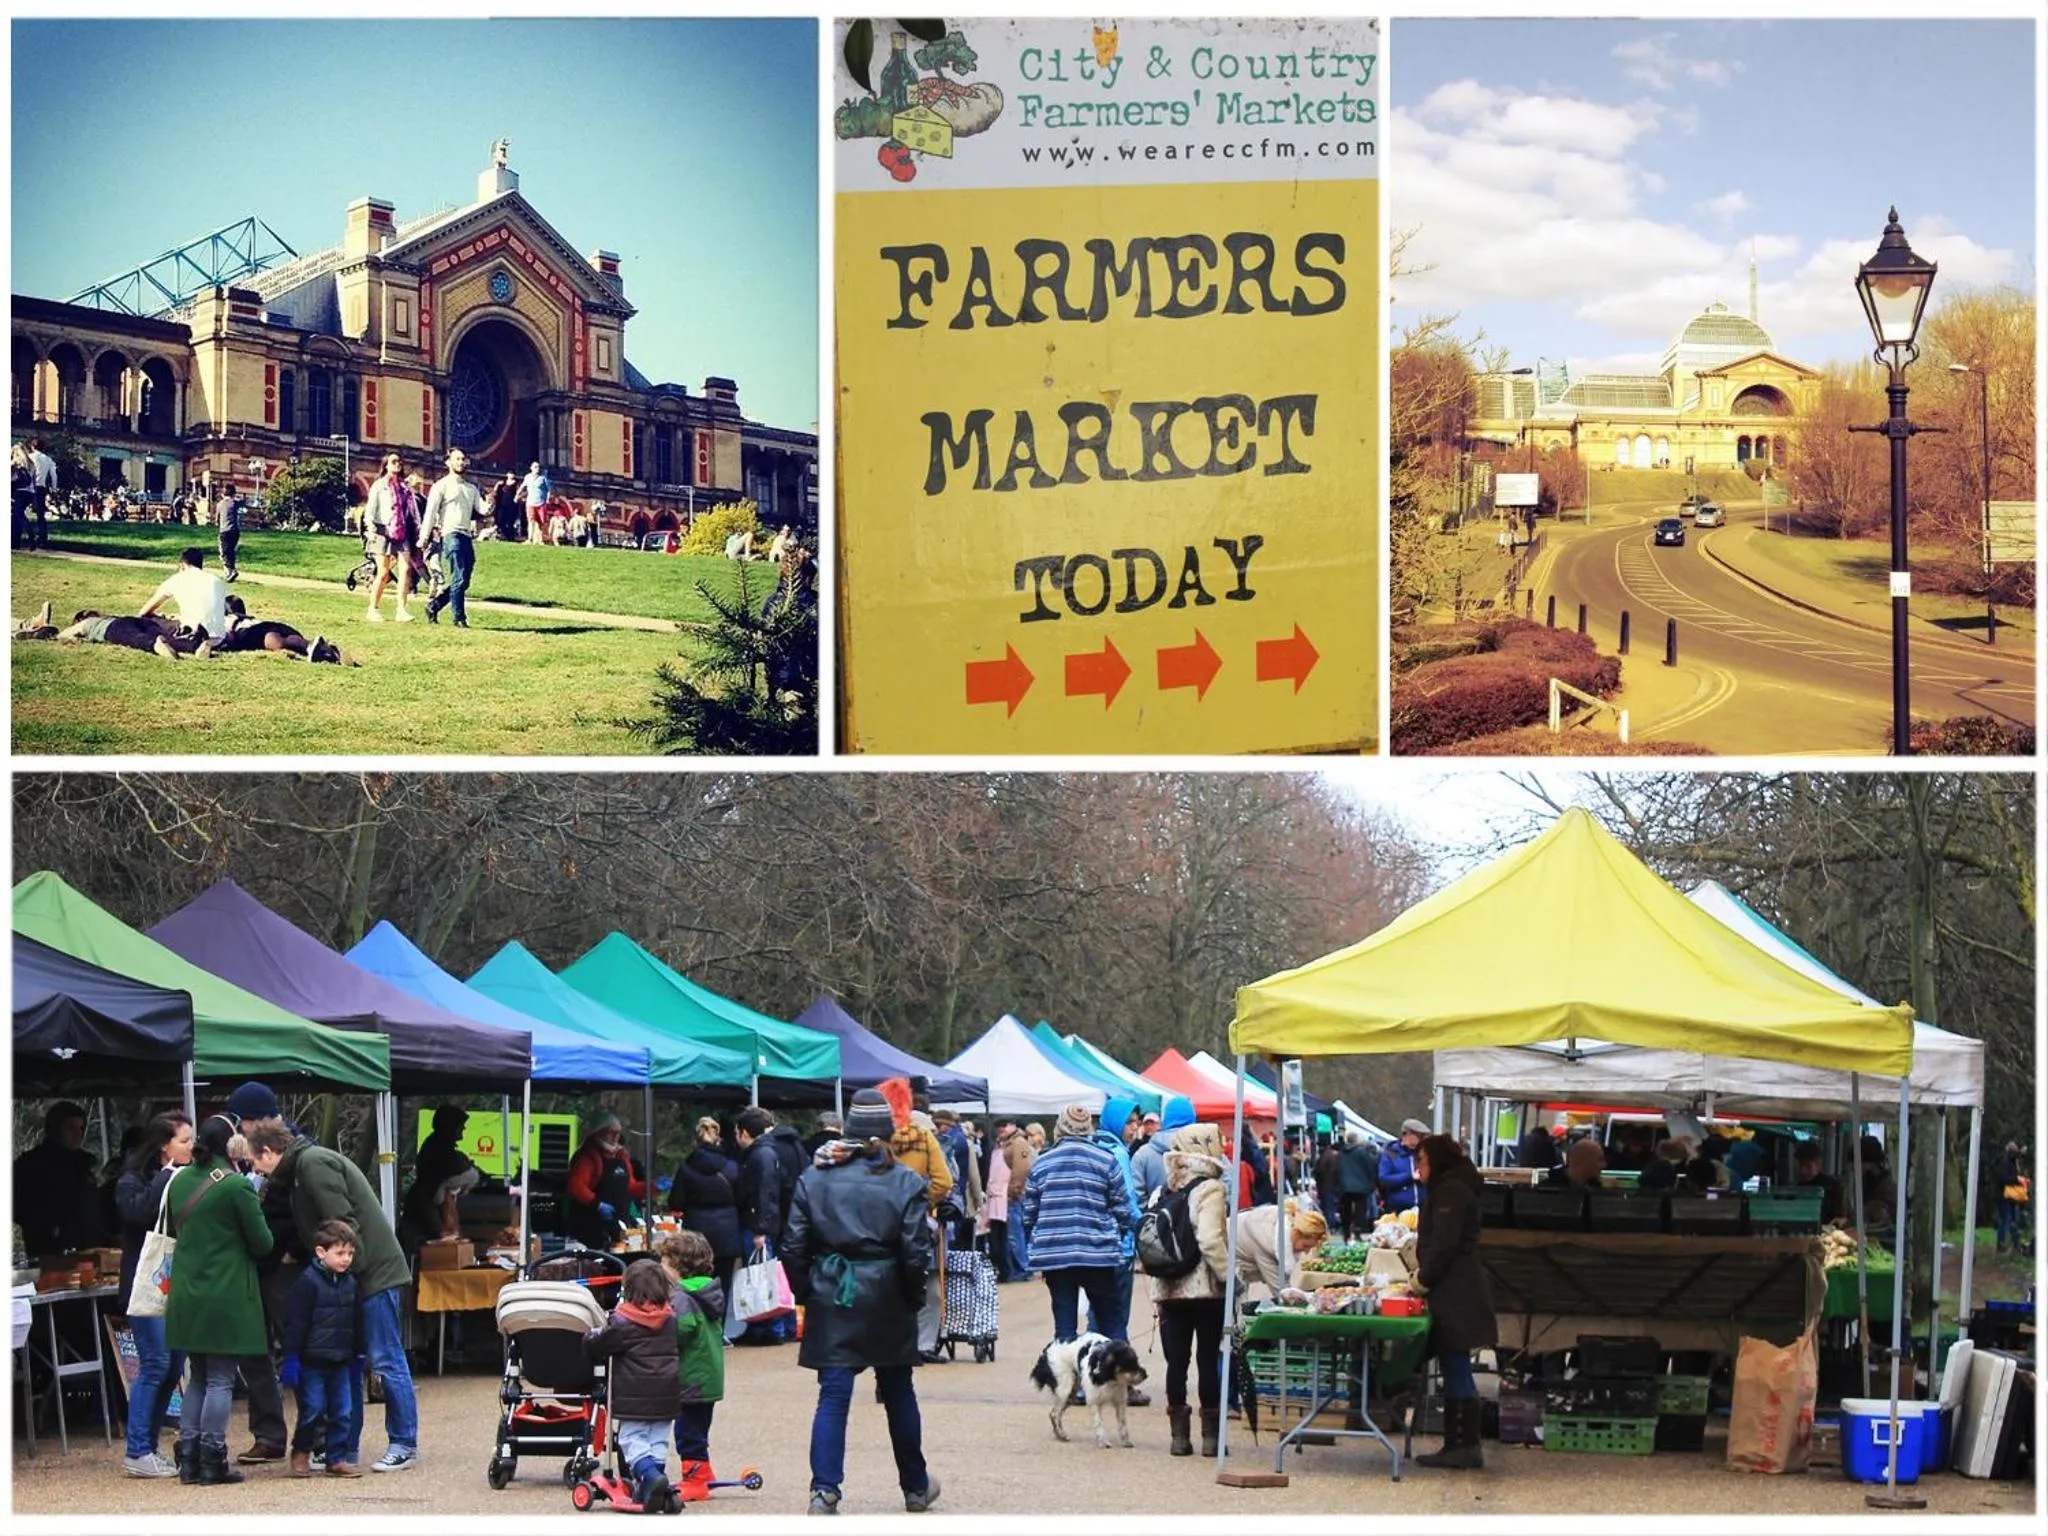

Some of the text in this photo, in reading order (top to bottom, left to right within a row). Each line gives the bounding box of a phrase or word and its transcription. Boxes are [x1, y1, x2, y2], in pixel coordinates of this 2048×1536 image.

[1019, 45, 1377, 89] City & Country
[1017, 88, 1377, 129] Farmers' Markets
[1022, 138, 1375, 162] www.weareccfm.com
[880, 231, 1347, 330] FARMERS
[919, 393, 1319, 497] MARKET
[1014, 534, 1264, 624] TODAY
